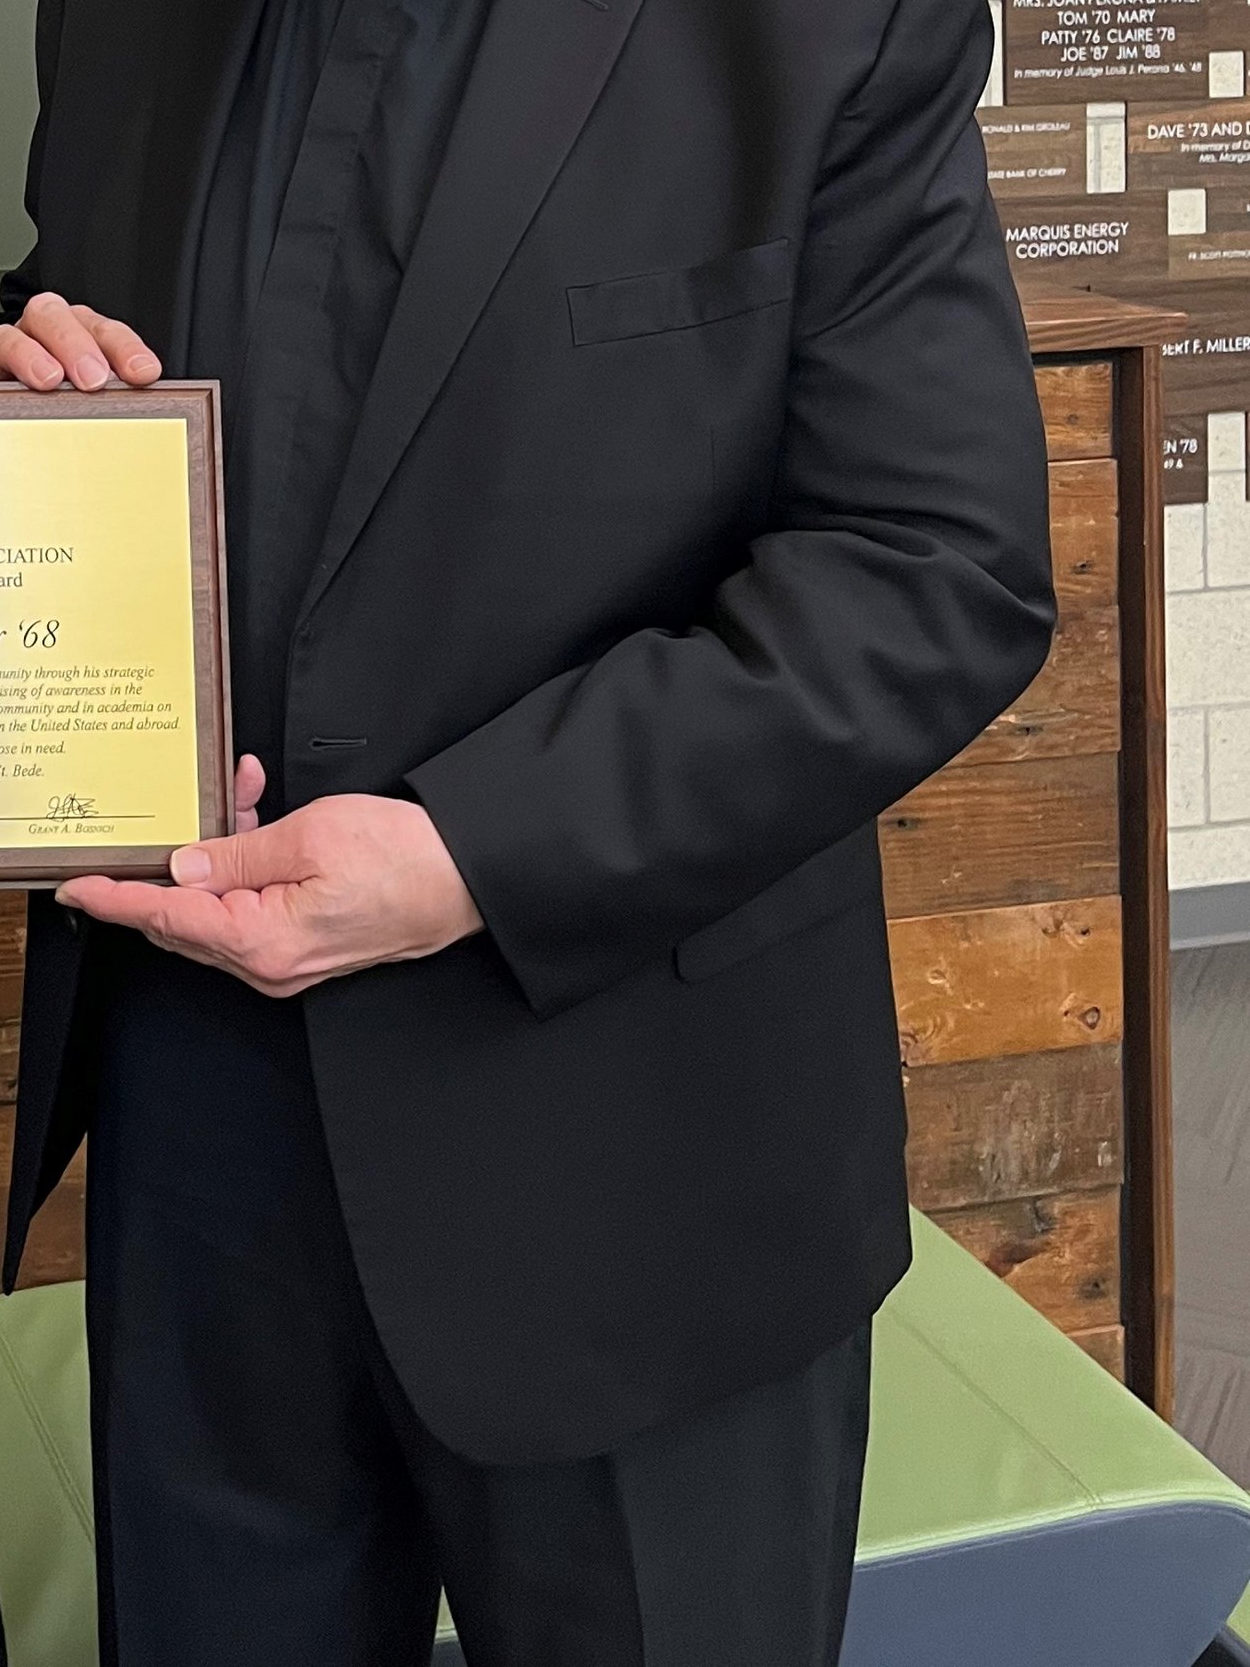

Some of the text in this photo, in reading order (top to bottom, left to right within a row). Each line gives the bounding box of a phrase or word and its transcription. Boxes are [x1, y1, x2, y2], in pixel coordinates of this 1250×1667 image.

[1056, 8, 1155, 26] TOM '70 MARY
[1041, 27, 1175, 45] PATTY '76 CLAIRE '78
[1060, 44, 1161, 62] JOE '87 JIM '88
[1146, 123, 1185, 140] DAVE
[1188, 122, 1208, 137] '73
[1210, 120, 1243, 137] AND
[1005, 221, 1129, 243] MARQUIS ENERGY
[1015, 238, 1119, 259] CORPORATION
[34, 665, 80, 683] through
[82, 665, 101, 678] his
[102, 664, 155, 681] strategic
[30, 683, 45, 701] of
[45, 686, 106, 697] awareness
[109, 683, 121, 696] in
[124, 681, 143, 696] the
[56, 700, 81, 714] and
[82, 701, 94, 714] in
[96, 699, 154, 714] academia
[156, 702, 172, 713] on
[8, 718, 27, 732] the
[30, 717, 71, 732] United
[72, 717, 108, 731] States
[110, 716, 135, 731] and
[135, 716, 180, 730] abroad.
[20, 742, 32, 754] in
[35, 740, 66, 754] need.
[11, 763, 44, 778] Bede.
